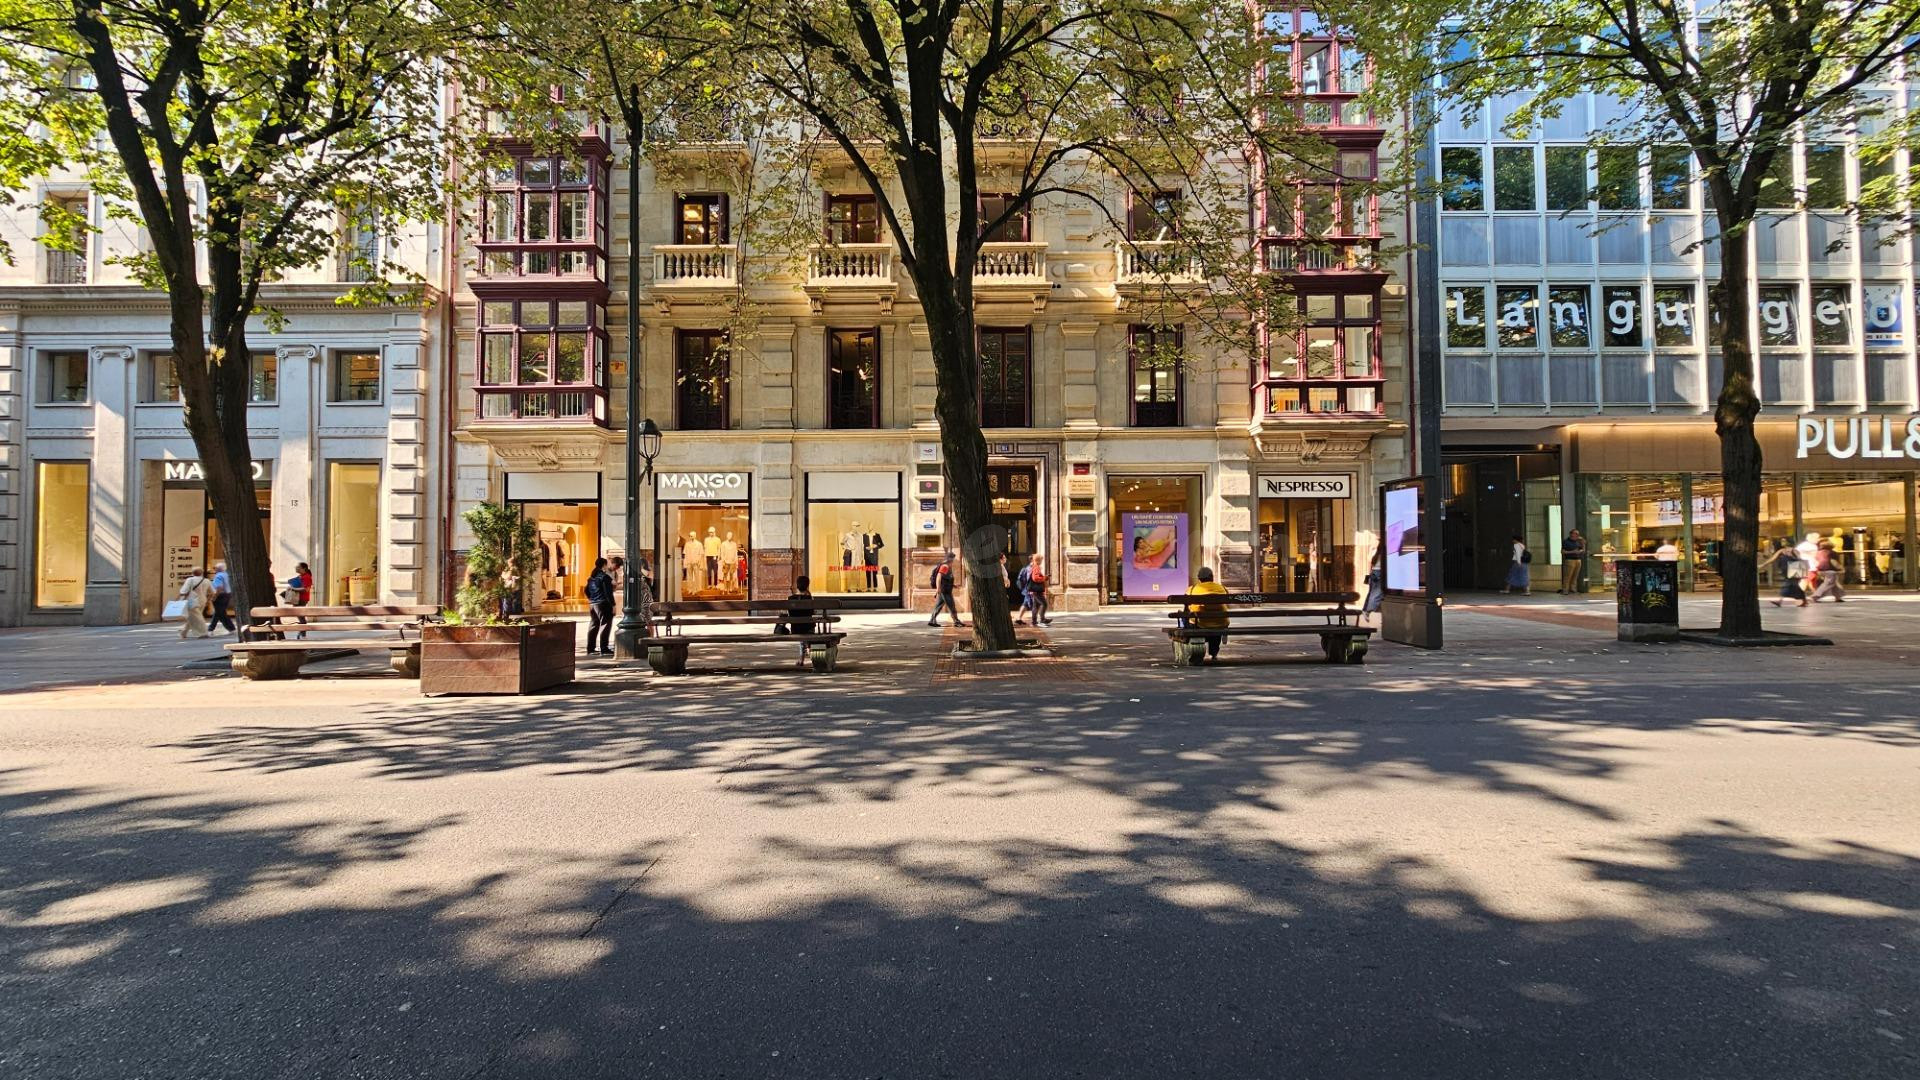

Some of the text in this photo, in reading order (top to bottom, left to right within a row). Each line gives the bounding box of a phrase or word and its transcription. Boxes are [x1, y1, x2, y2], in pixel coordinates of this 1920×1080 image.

[1452, 290, 1841, 335] Languge
[164, 461, 263, 480] MAO
[661, 473, 741, 488] MANGO
[1263, 478, 1343, 494] NESPRESSO
[687, 490, 715, 498] MAN
